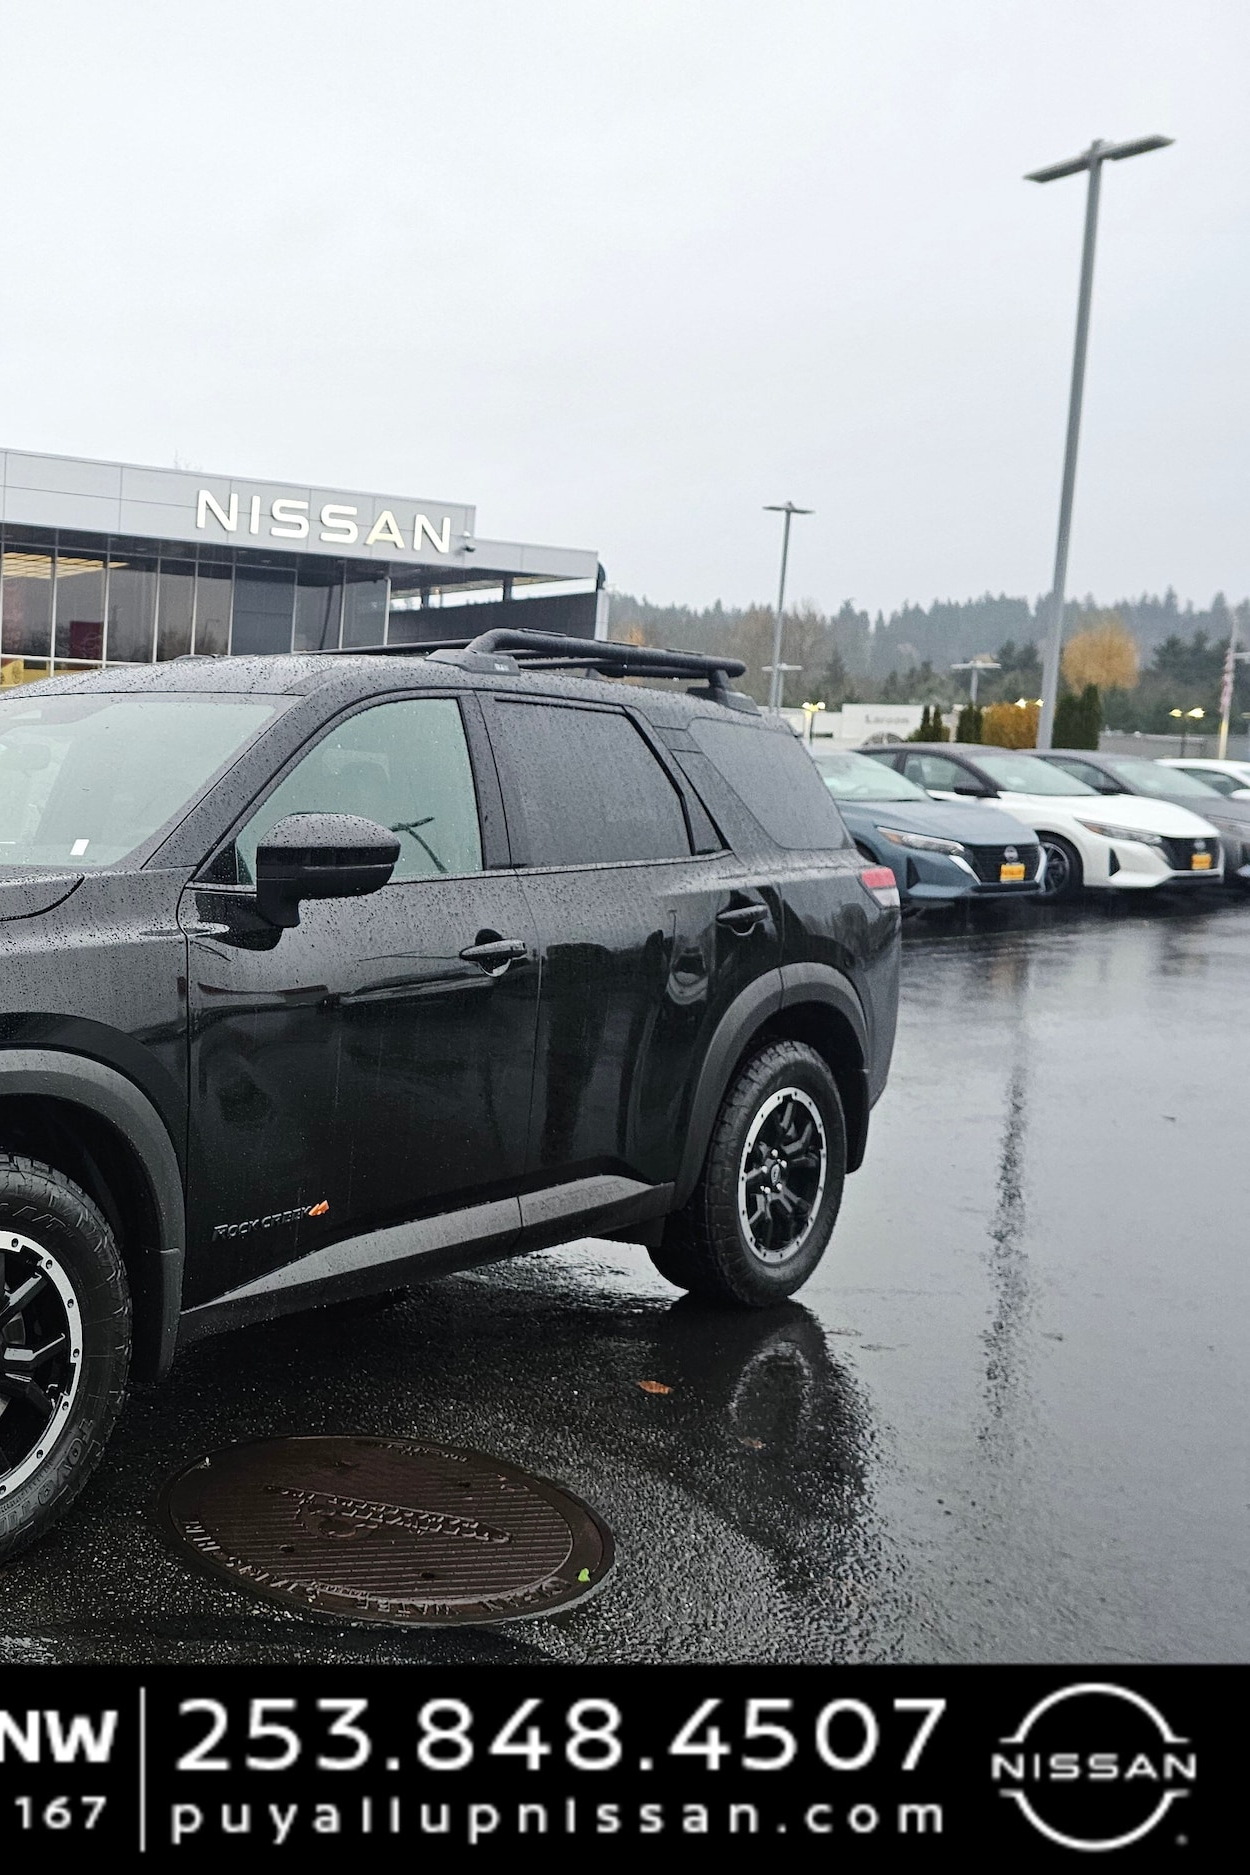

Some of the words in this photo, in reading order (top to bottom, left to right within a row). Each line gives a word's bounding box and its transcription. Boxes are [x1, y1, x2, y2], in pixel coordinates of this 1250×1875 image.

[196, 489, 452, 554] NISSAN
[212, 1219, 260, 1241] ROCK
[37, 1417, 95, 1506] TOYO
